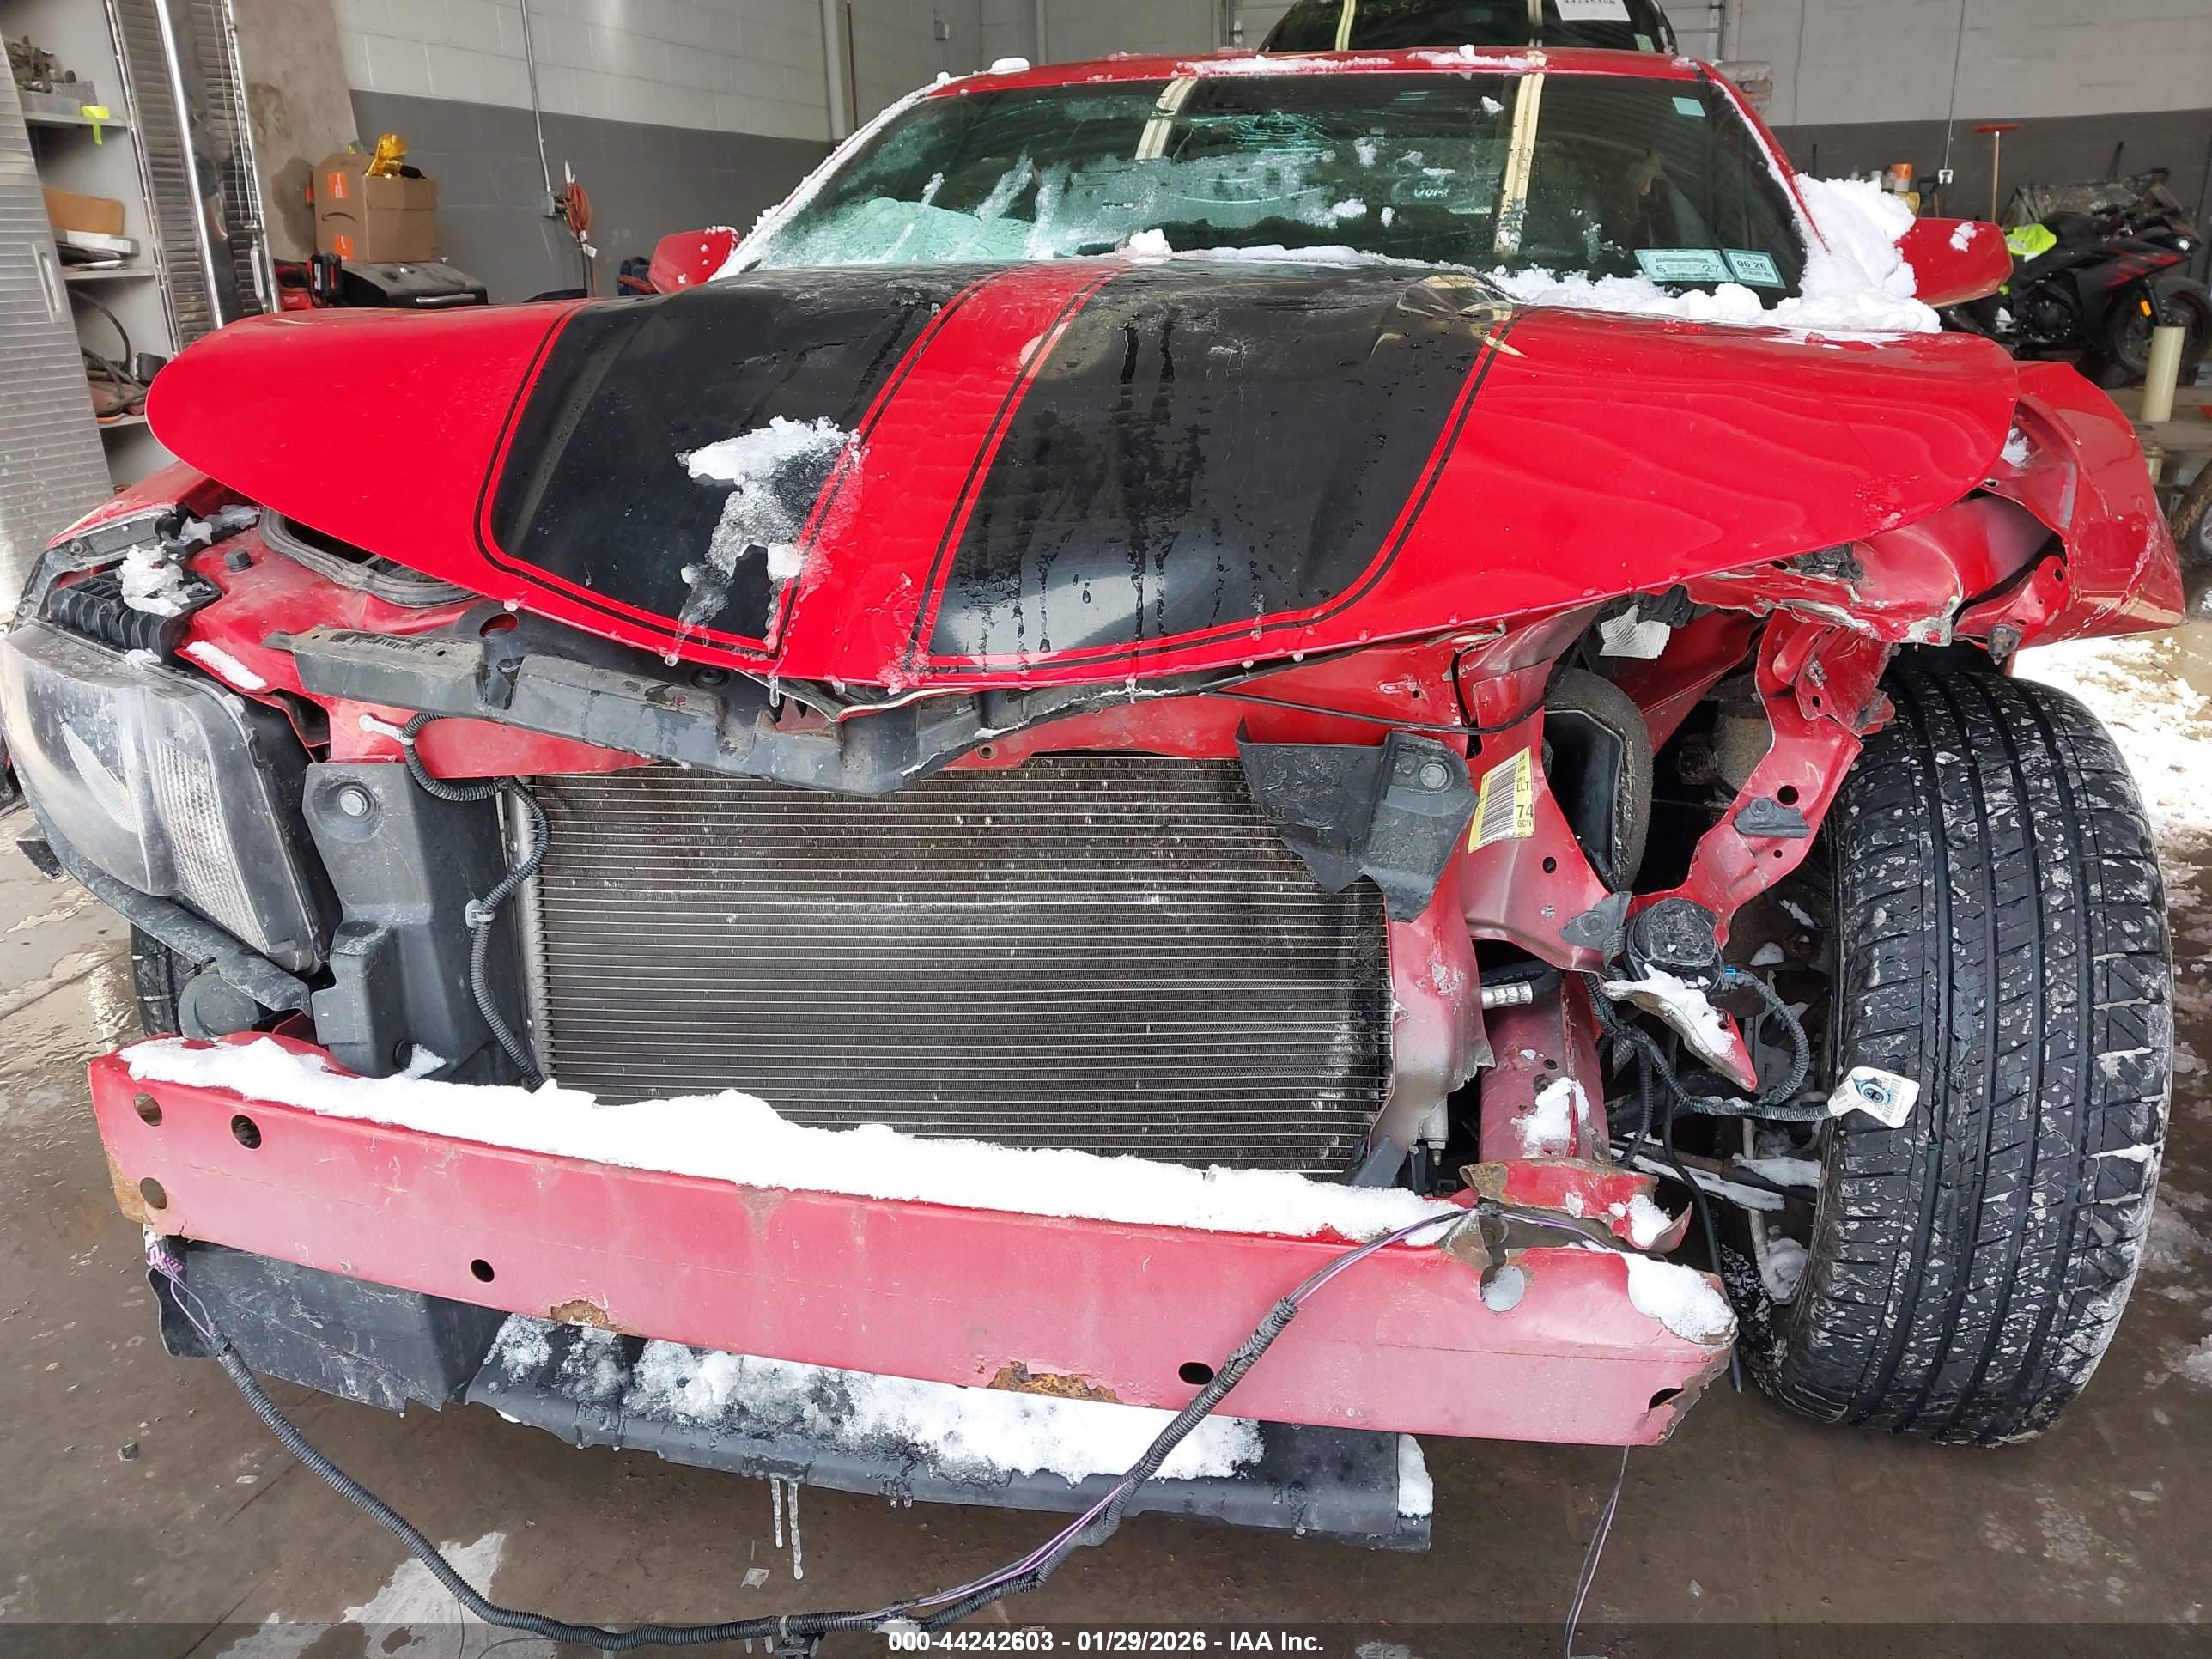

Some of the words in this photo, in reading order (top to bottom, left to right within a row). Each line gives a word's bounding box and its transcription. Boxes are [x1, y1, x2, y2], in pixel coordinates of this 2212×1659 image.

[1701, 264, 1719, 273] 27
[1753, 261, 1767, 270] 26
[1516, 781, 1530, 793] LLT
[1516, 803, 1534, 819] 74
